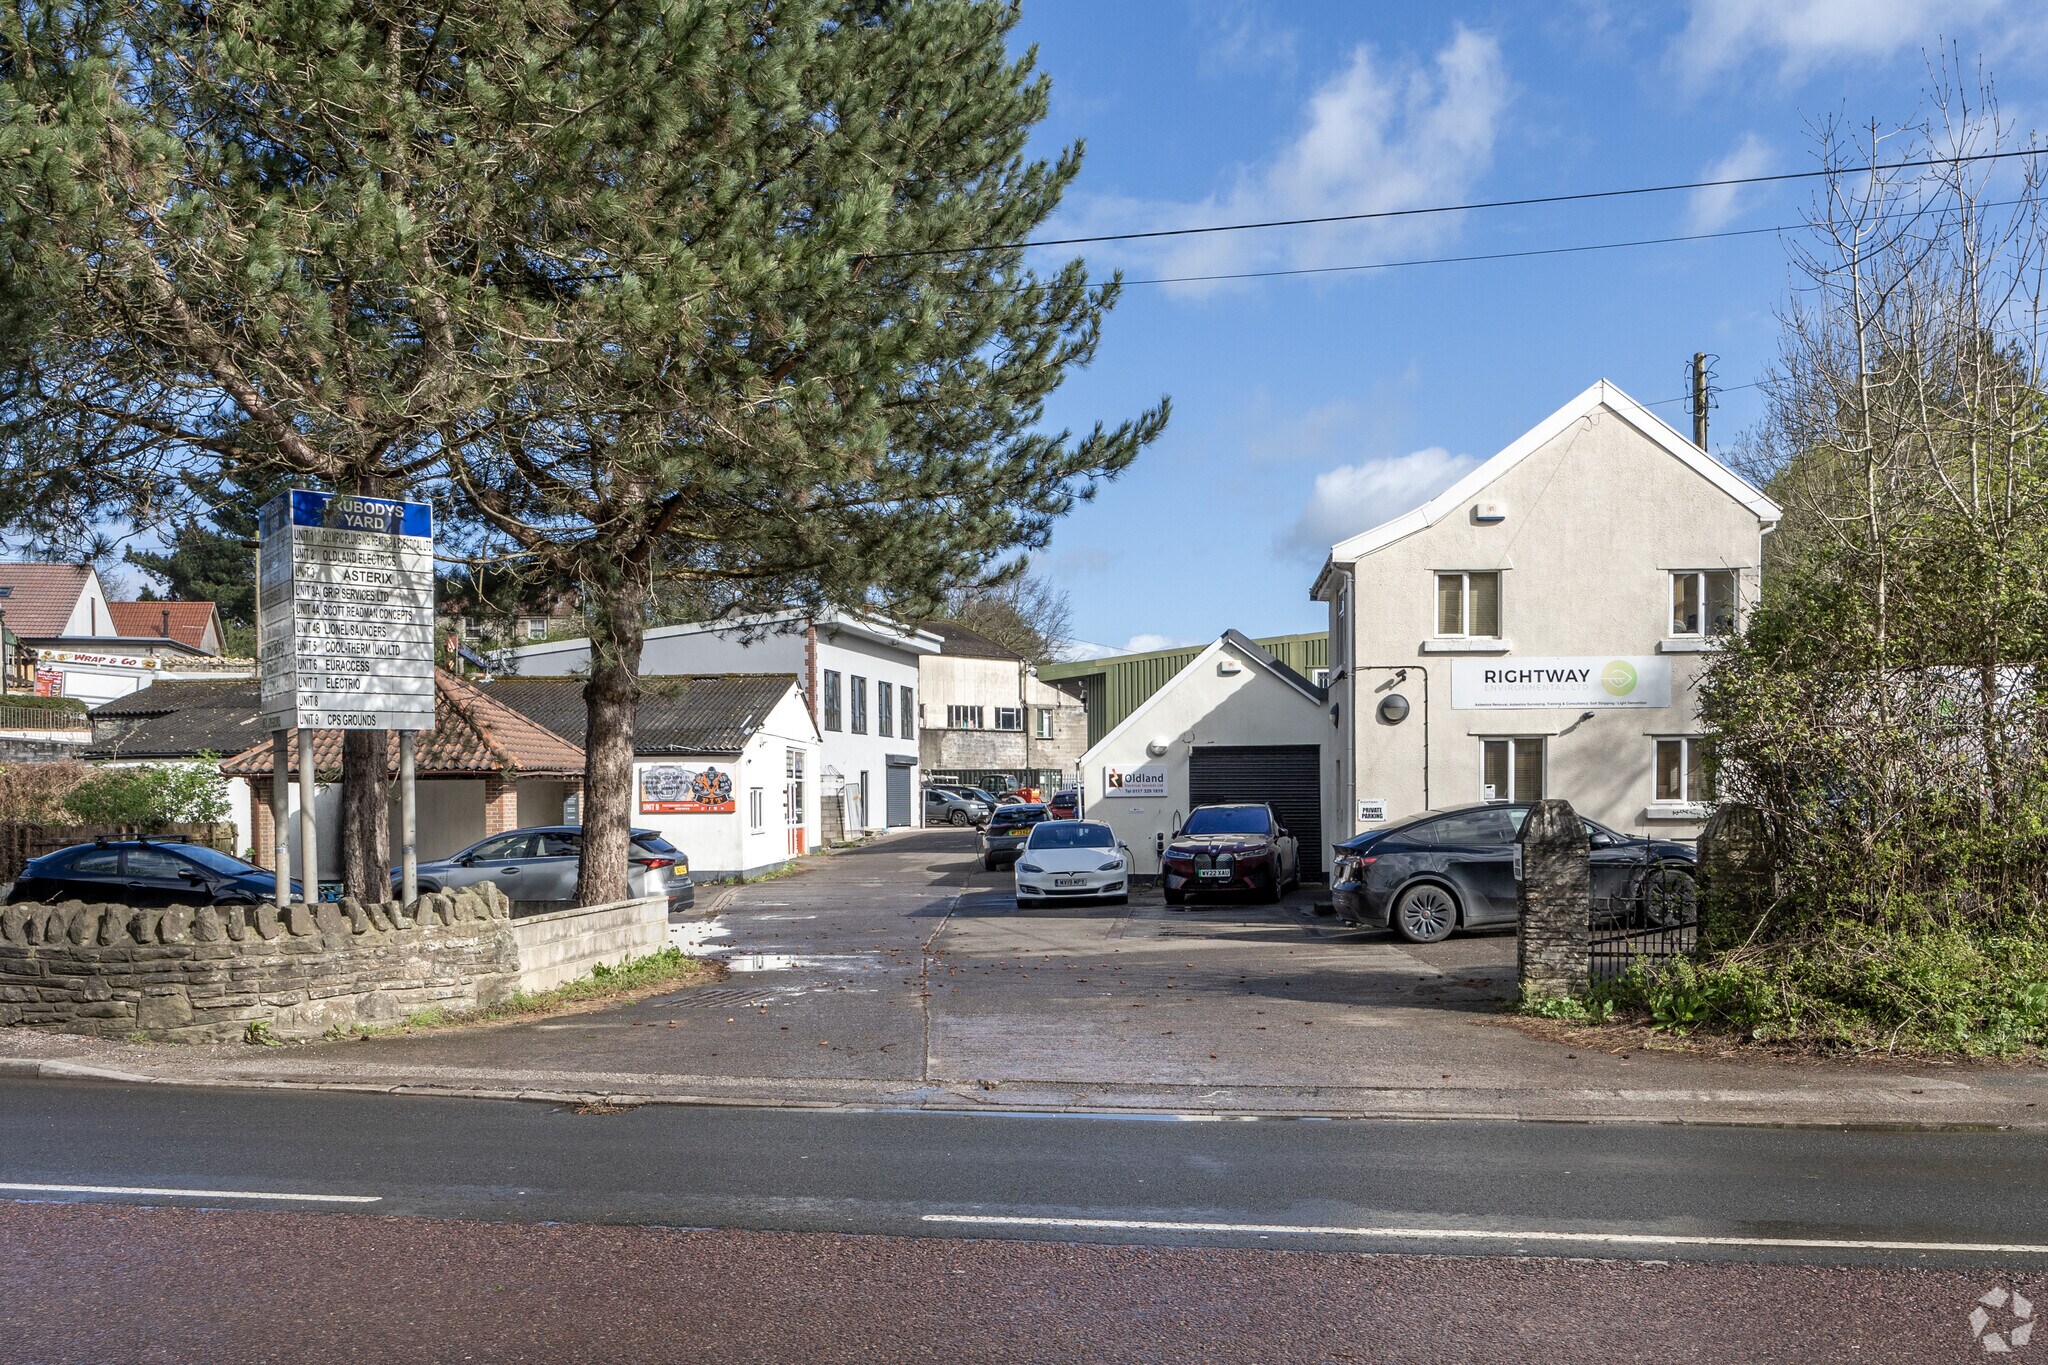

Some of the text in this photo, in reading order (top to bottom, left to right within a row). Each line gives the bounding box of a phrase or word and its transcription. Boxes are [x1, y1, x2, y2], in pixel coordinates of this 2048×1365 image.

[345, 515, 384, 529] YARD
[294, 529, 308, 541] UNIT
[295, 549, 397, 566] UNIT 2 OLDLAND ELECTRICS
[295, 565, 310, 577] UNIT
[343, 570, 393, 584] ASTERIX
[296, 585, 389, 602] UNIT 3A GRIP SERVICES LTD
[296, 603, 412, 621] UNIT 4A SCOTT READMAN CONCEPTS
[296, 622, 387, 637] UNIT 4B LIONEL SAUNDERS
[297, 641, 400, 656] UNIT 5 COOL-THERM (UK) LTD
[297, 659, 370, 672] UNIT 6 EURACCESS
[299, 677, 312, 688] UNIT
[313, 677, 318, 688] 7
[1485, 669, 1590, 683] RIGHTWAY
[299, 696, 319, 707] UNIT 8
[300, 714, 376, 726] UNIT 9 CPS GROUNDS
[1125, 773, 1163, 783] Oldland
